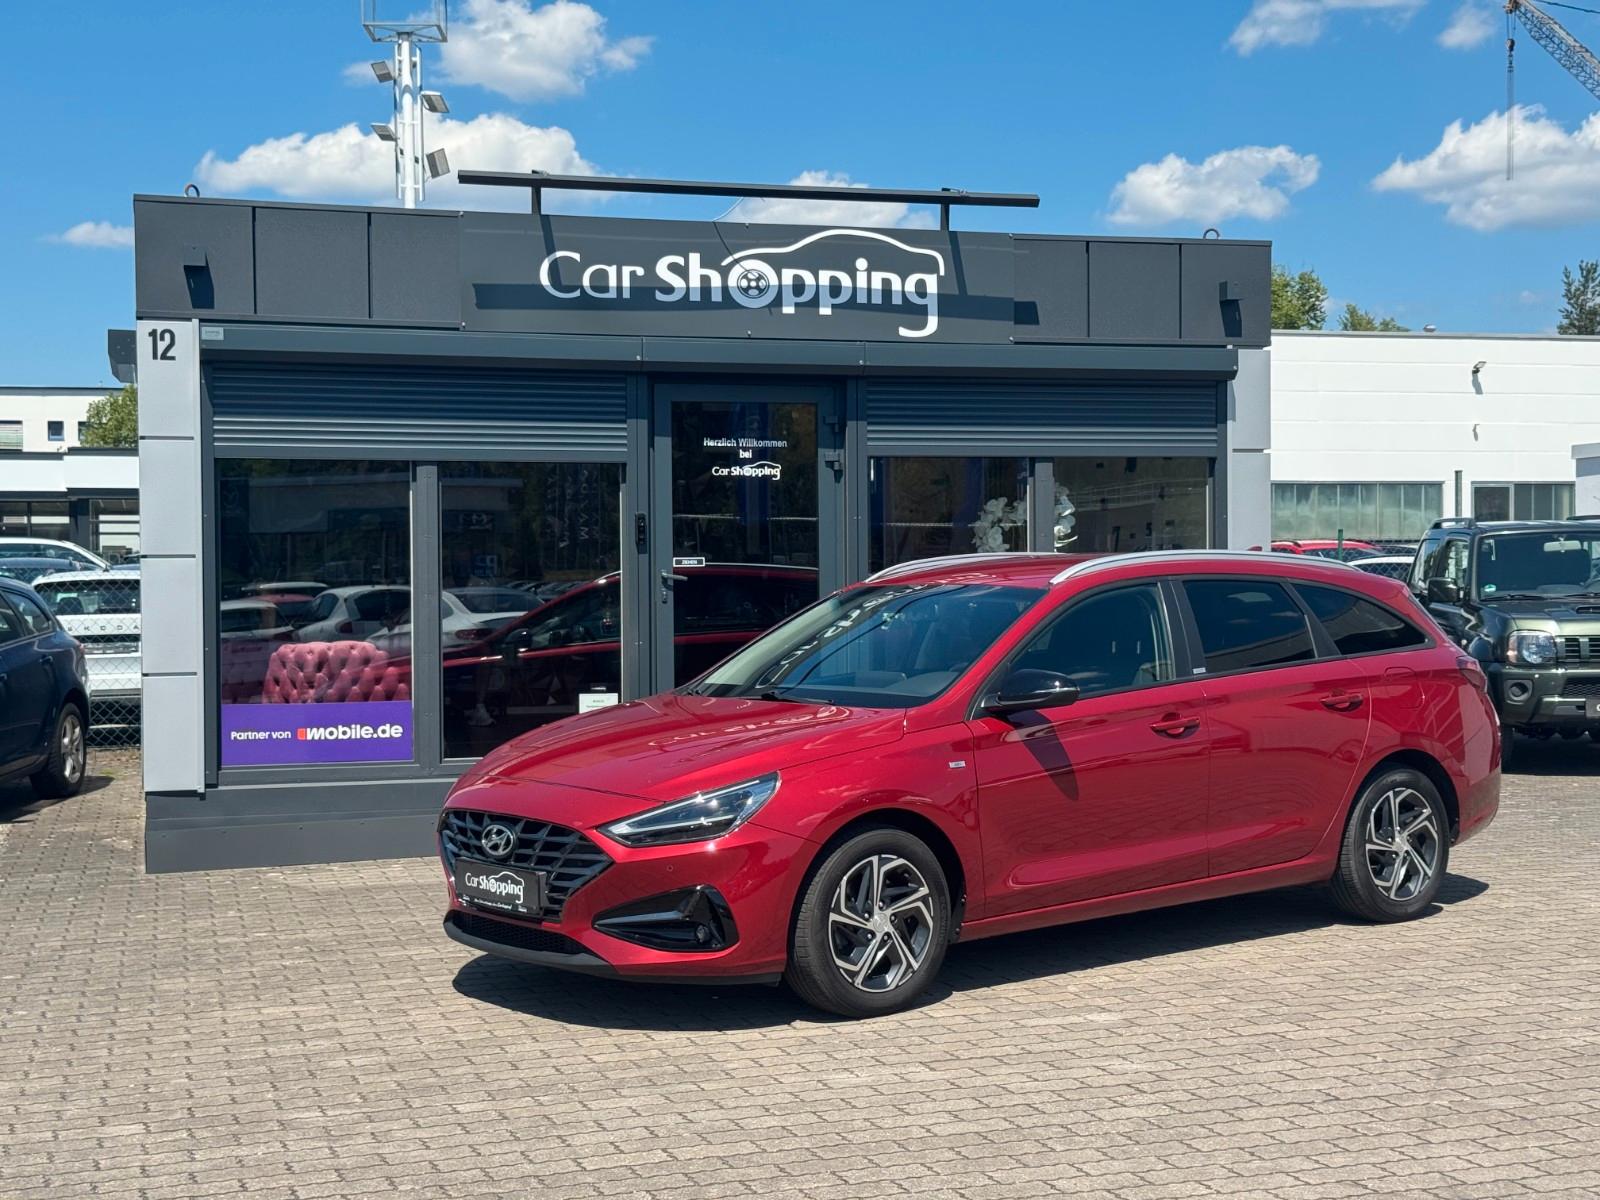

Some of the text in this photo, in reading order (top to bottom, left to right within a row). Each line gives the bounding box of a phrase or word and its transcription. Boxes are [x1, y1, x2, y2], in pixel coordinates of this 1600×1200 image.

[539, 250, 941, 338] Car Shopping
[148, 328, 176, 361] 12
[703, 437, 788, 448] Herzlich Willkommen
[739, 449, 752, 459] bei
[711, 465, 781, 481] Car Shopping
[230, 731, 270, 740] Partner
[271, 730, 291, 739] von
[465, 872, 480, 887] Car
[480, 873, 524, 904] Shopping
